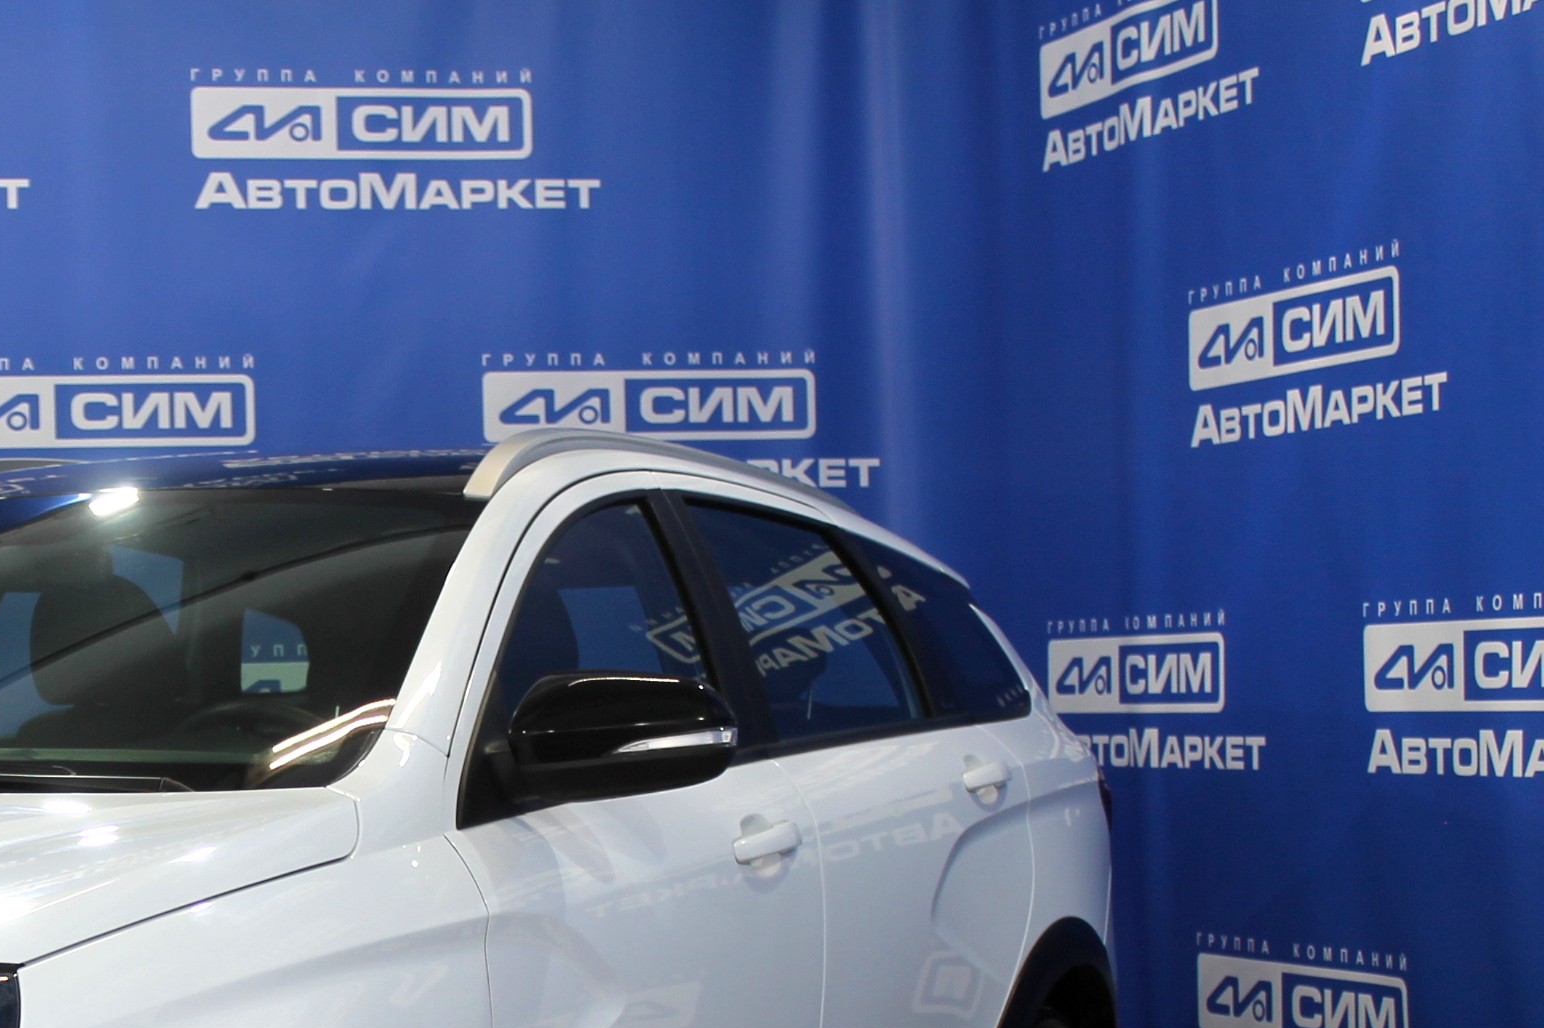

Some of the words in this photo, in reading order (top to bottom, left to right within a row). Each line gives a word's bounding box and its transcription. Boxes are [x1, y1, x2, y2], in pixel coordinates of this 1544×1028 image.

[1038, 3, 1103, 41] ГРУППА
[1116, 0, 1206, 70] СИМ
[190, 67, 317, 82] ГРУППА
[354, 67, 532, 84] КОМПАНИЙ
[351, 104, 511, 143] СИМ
[1188, 274, 1263, 306] ГРУППА
[1283, 239, 1401, 282] КОМПАНИЙ
[1282, 289, 1386, 353] СИМ
[72, 353, 255, 371] КОМПАНИЙ
[481, 352, 606, 367] ГРУППА
[642, 349, 816, 366] КОМПАНИЙ
[70, 391, 233, 431] СИМ
[639, 385, 795, 424] СИМ
[1047, 617, 1110, 634] ГРУППА
[1362, 597, 1451, 618] ГРУППА
[1125, 651, 1213, 695] СИМ
[1078, 728, 1266, 770] тоМаркет
[1196, 932, 1270, 955] ГРУППА
[1293, 944, 1407, 971] КОМПАНИЙ
